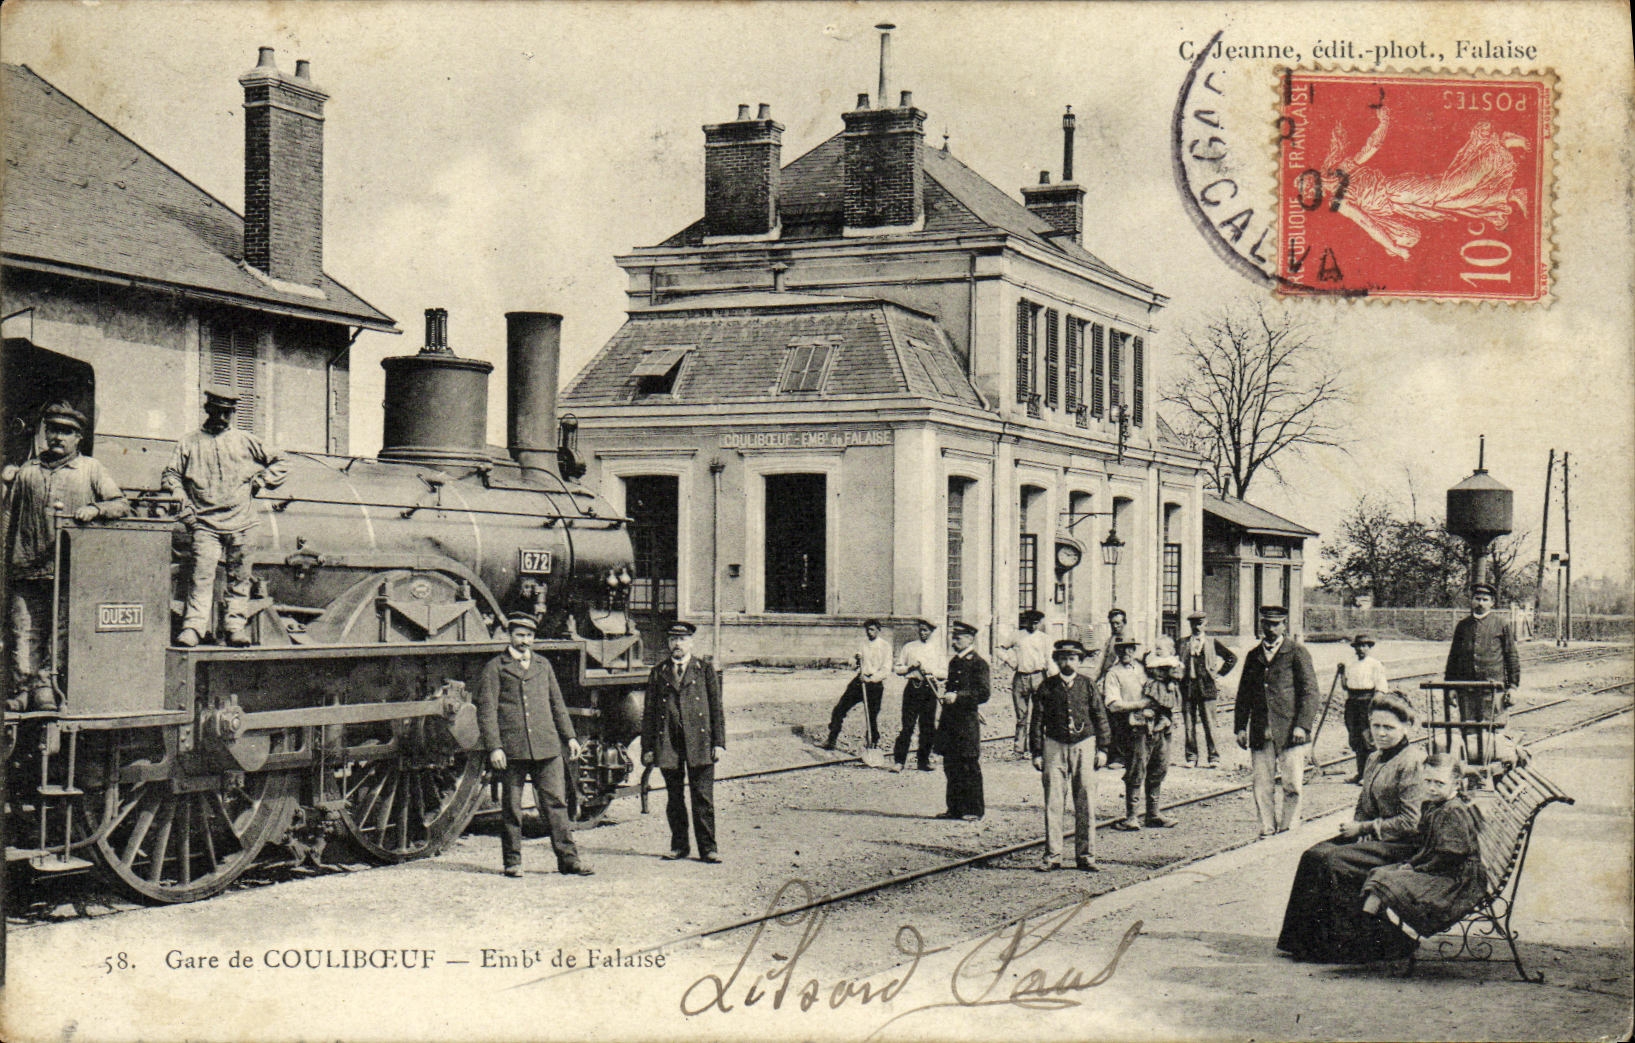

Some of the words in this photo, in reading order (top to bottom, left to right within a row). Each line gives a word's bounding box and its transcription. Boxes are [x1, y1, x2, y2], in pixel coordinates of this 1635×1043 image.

[1444, 90, 1528, 112] POSTES
[844, 431, 892, 446] FALAISE
[524, 553, 548, 570] 672
[102, 608, 140, 624] OUEST
